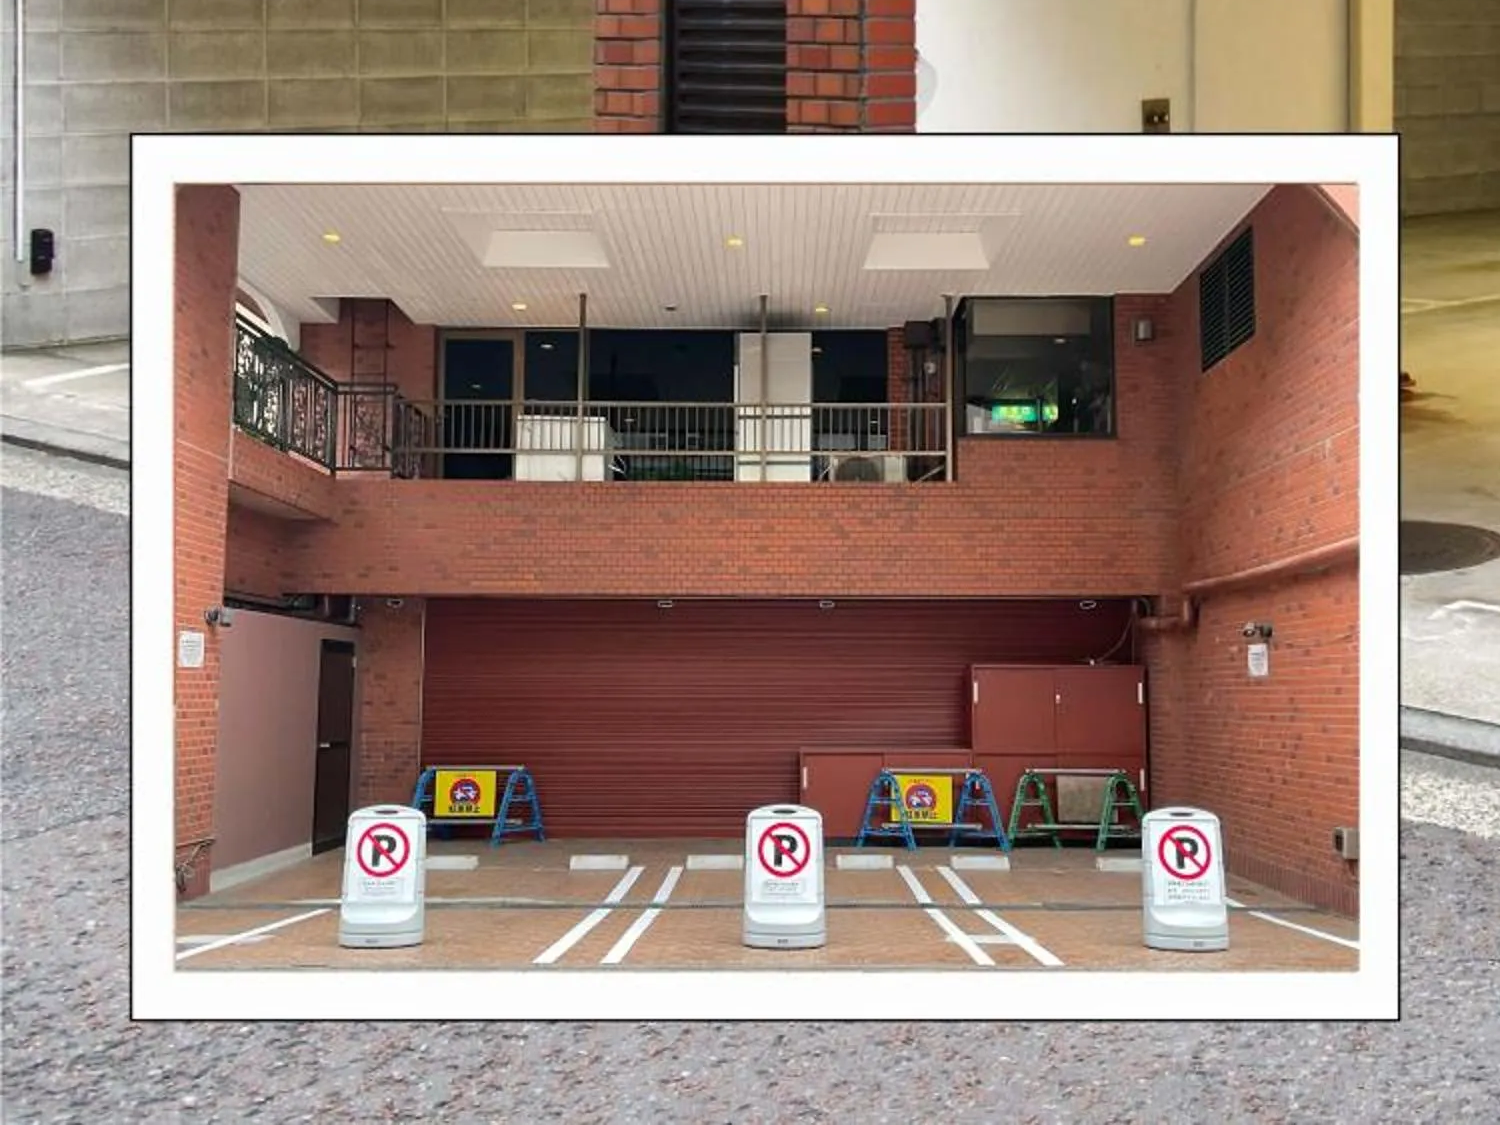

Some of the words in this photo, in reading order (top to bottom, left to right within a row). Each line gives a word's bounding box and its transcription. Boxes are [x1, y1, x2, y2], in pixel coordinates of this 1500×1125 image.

[371, 834, 397, 867] P
[773, 834, 798, 867] P
[1174, 836, 1199, 870] P
